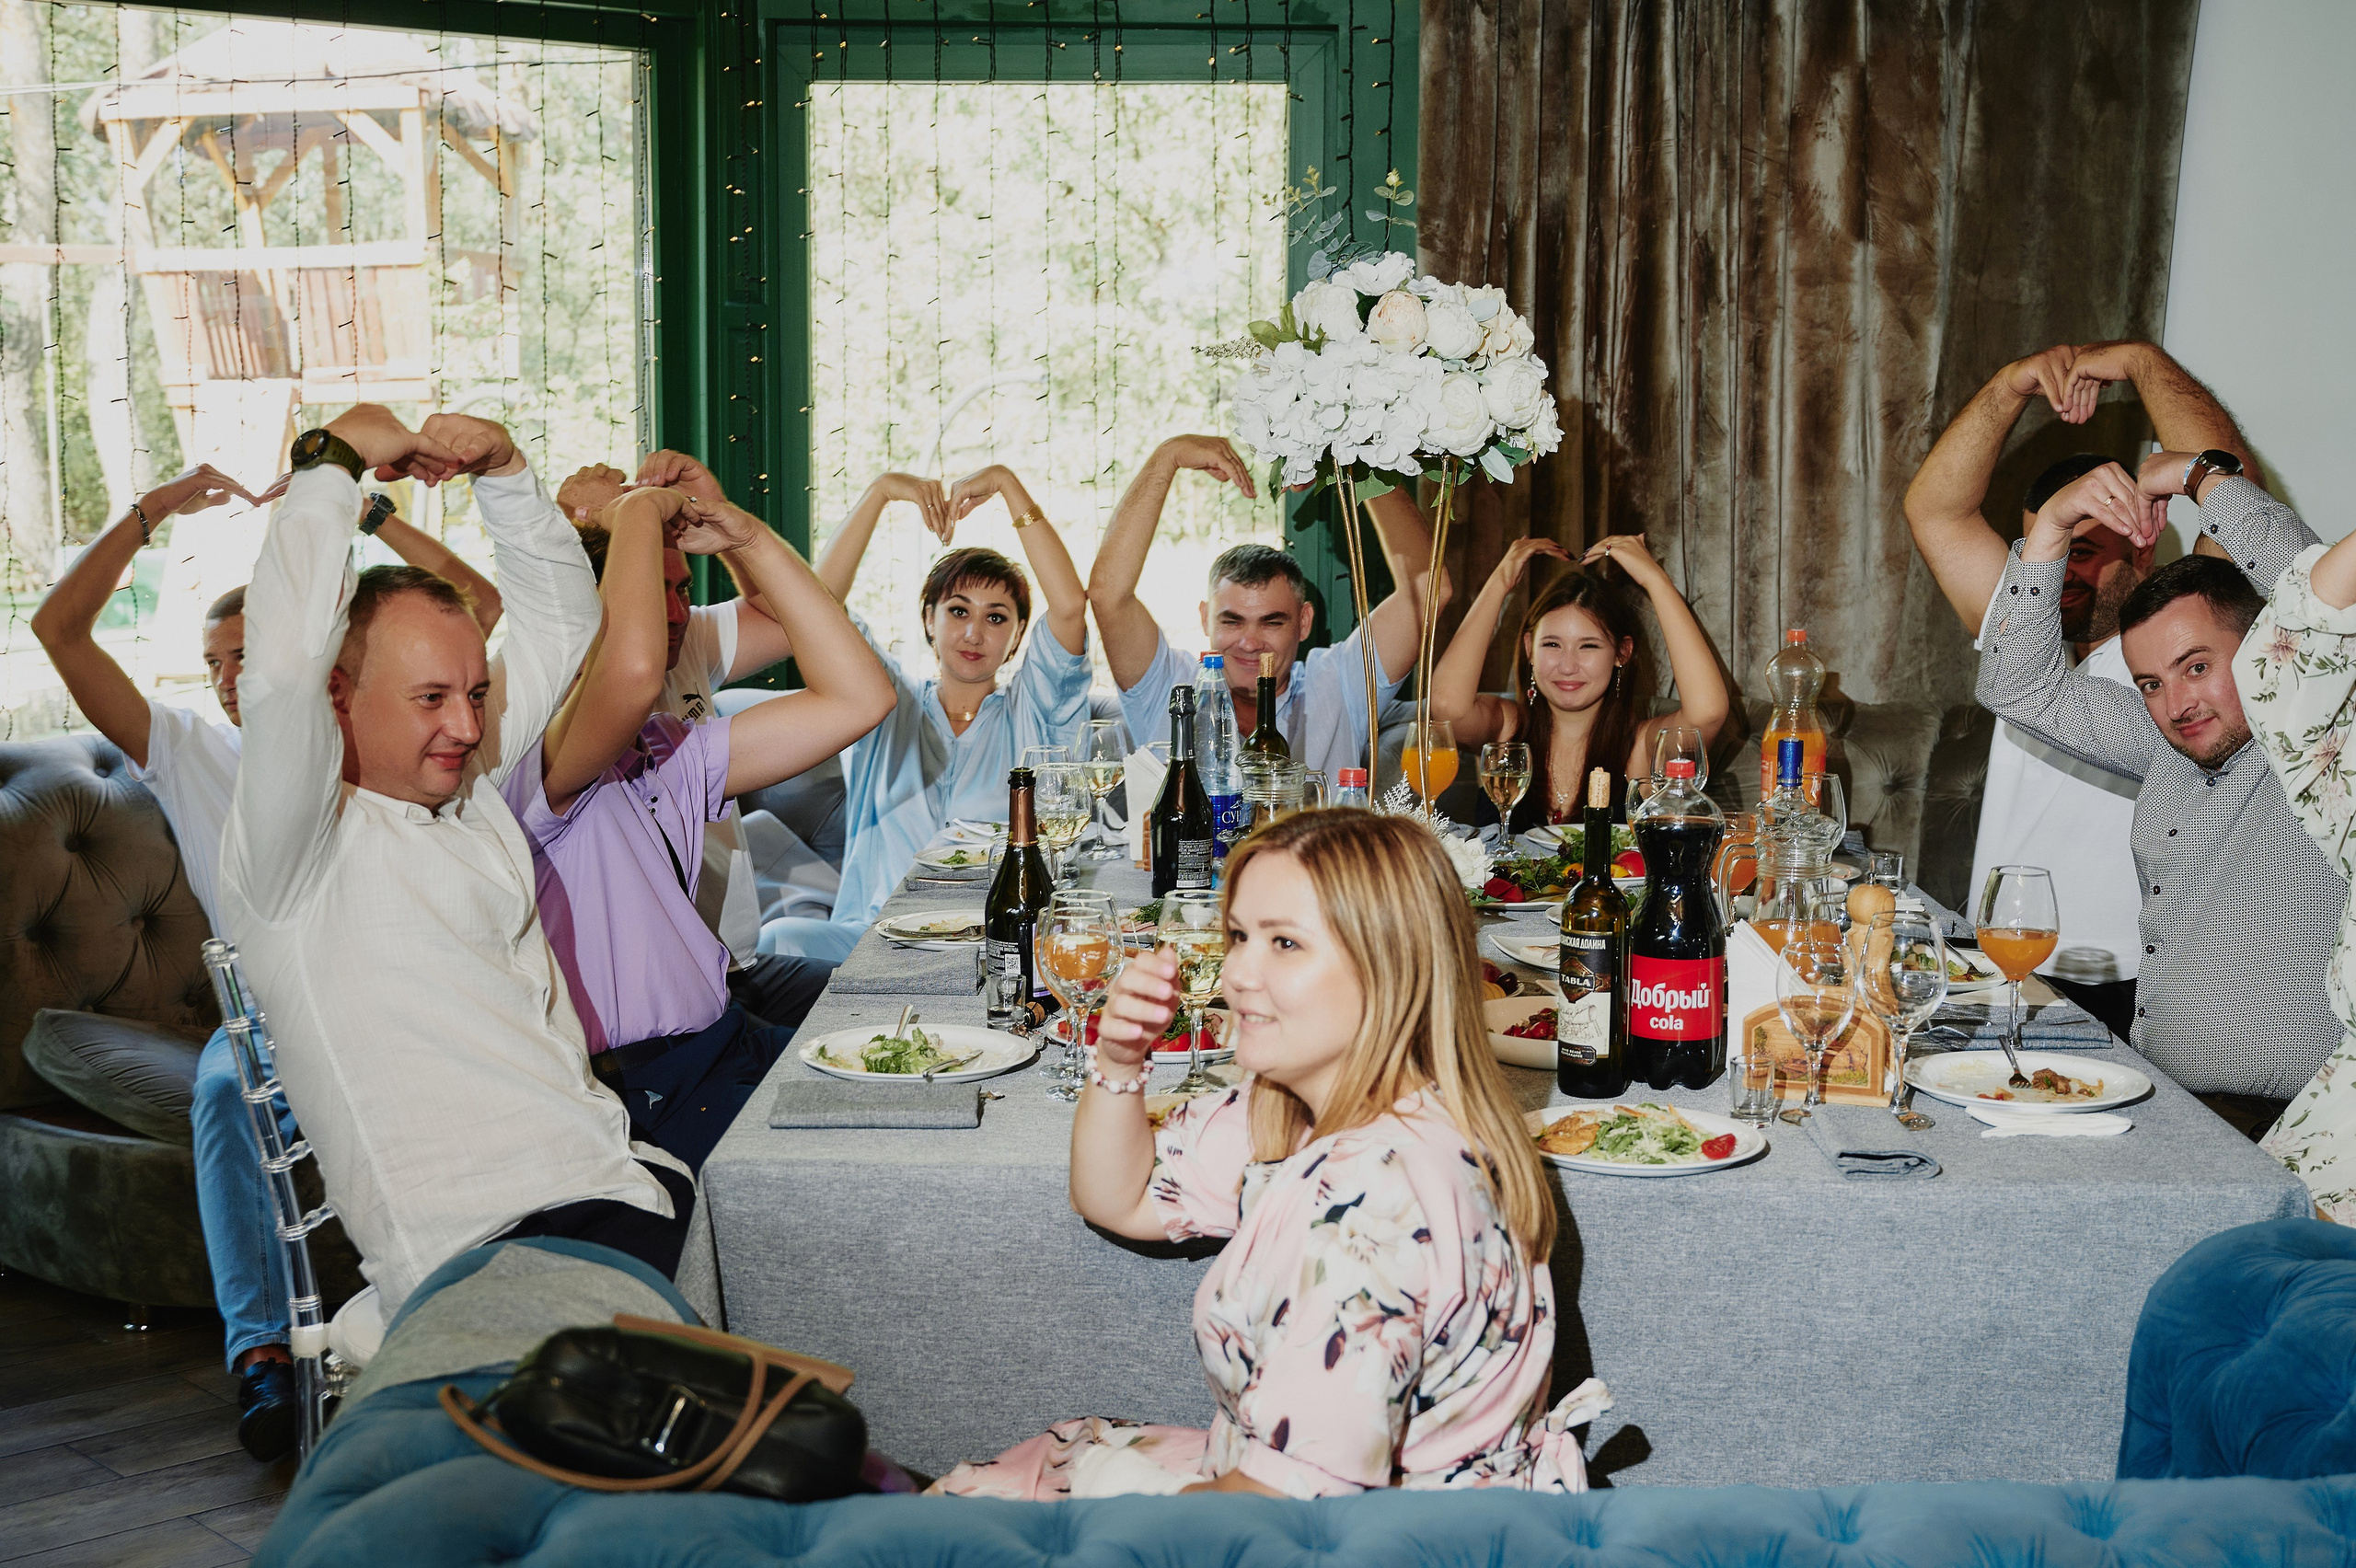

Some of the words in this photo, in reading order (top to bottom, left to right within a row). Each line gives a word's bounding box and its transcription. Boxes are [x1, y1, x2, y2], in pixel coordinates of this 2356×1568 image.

[681, 701, 706, 721] MA
[1221, 811, 1242, 824] СУН
[1580, 939, 1606, 950] ДОЛИНА
[1561, 974, 1591, 987] TABLA
[1631, 978, 1710, 1013] Добрый
[1649, 1015, 1684, 1030] cola
